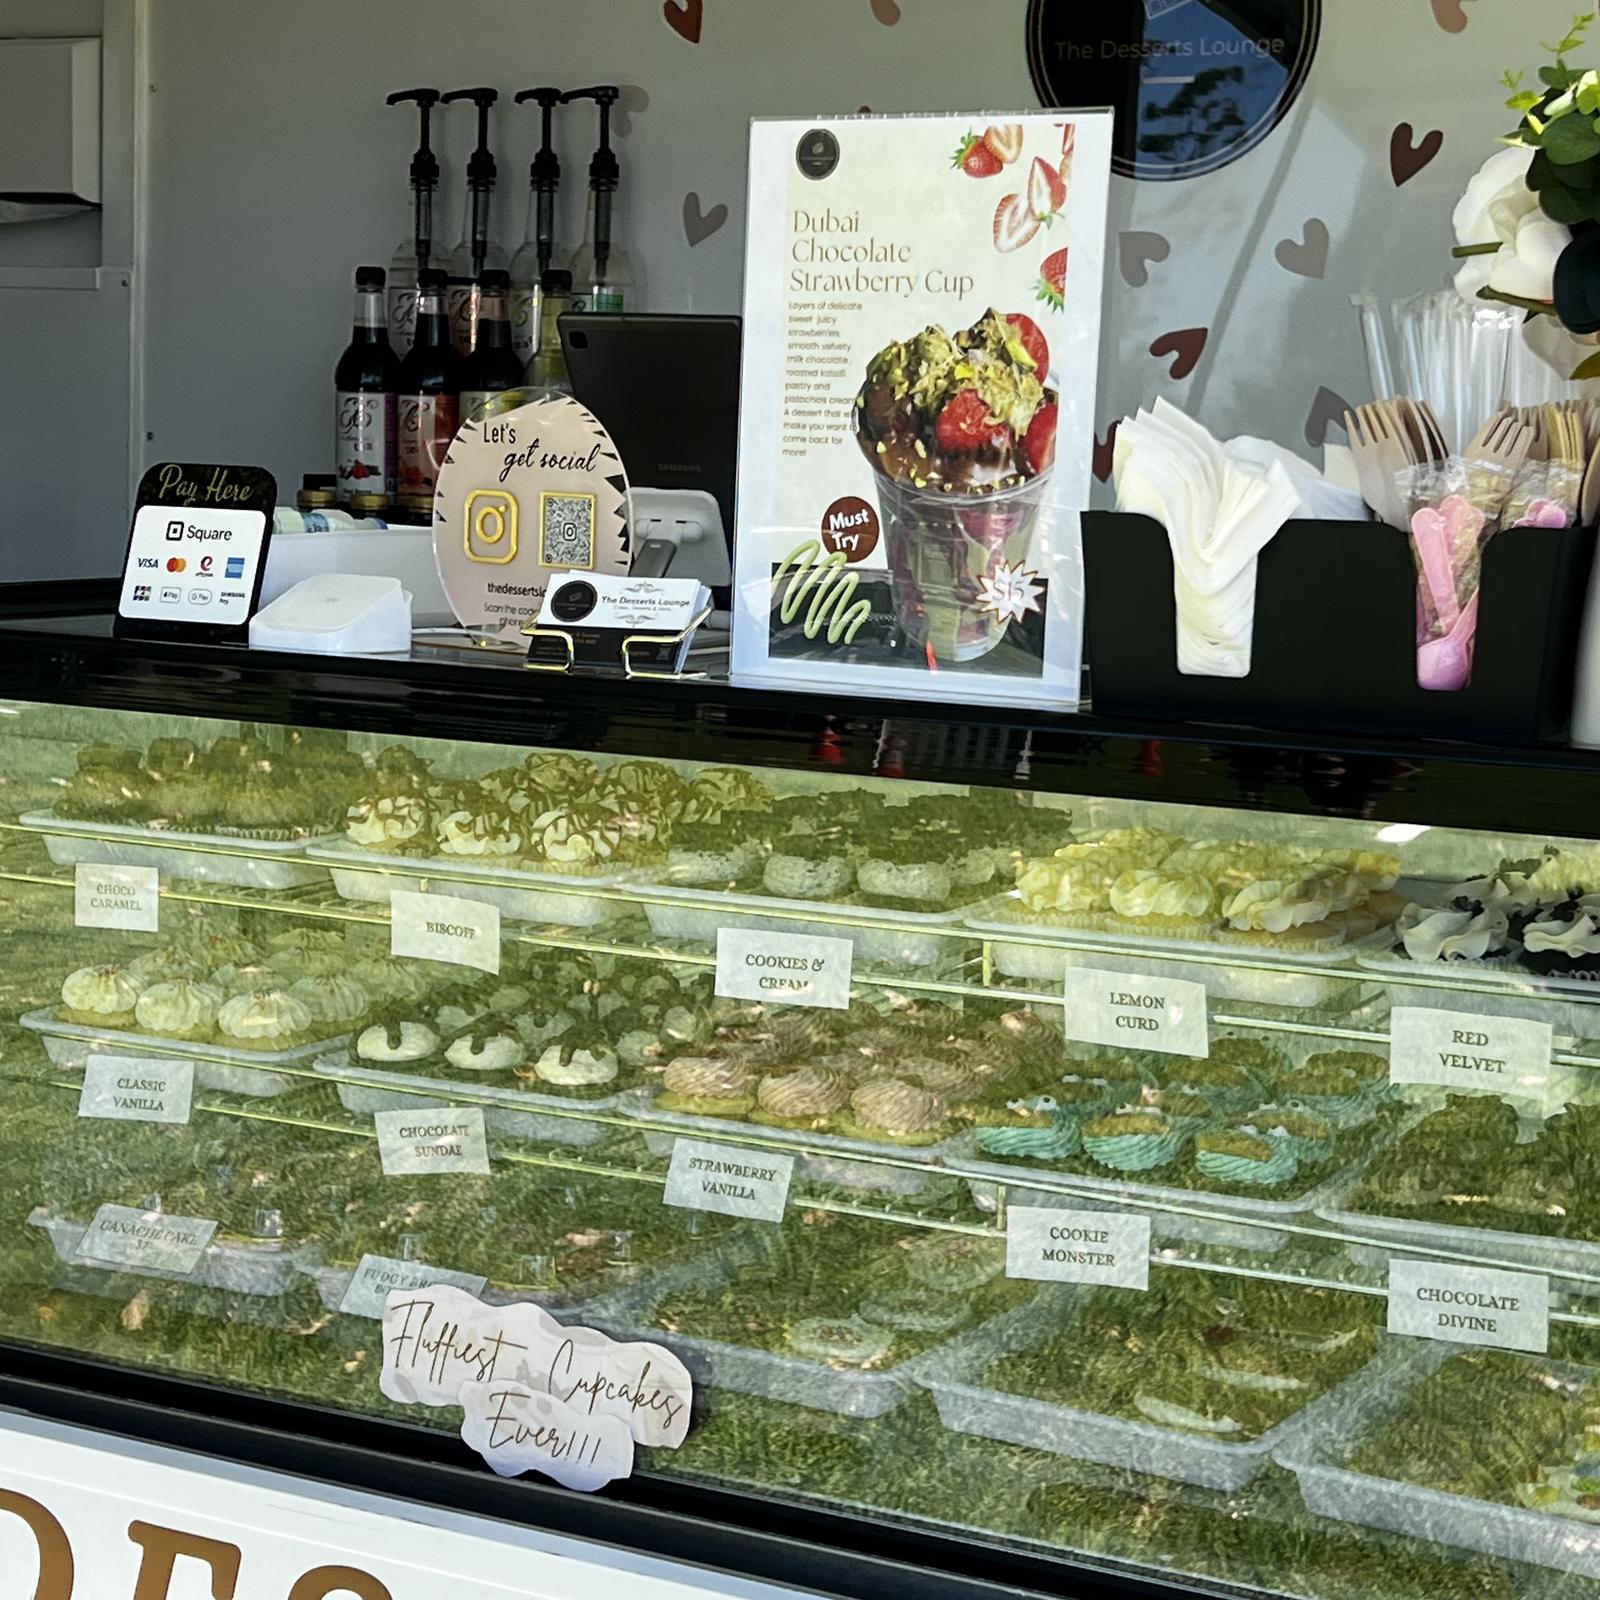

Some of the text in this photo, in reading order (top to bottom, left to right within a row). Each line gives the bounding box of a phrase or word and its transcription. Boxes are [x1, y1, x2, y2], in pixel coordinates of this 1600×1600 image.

[1054, 36, 1285, 60] The Desserts Lounge
[793, 208, 859, 233] Dubai
[792, 237, 911, 263] Chocolate
[790, 267, 974, 300] Strawberry Cup
[784, 408, 790, 416] A
[483, 422, 516, 444] Let's
[499, 438, 602, 483] get social
[158, 464, 254, 506] Pay Here
[829, 508, 869, 531] Must
[186, 525, 233, 543] Square
[832, 532, 859, 551] Try
[137, 558, 159, 569] VISA
[602, 596, 690, 607] The Desserts Lounge
[97, 884, 135, 897] CHOCO
[90, 897, 142, 911] CARAMEL
[745, 953, 824, 972] COOKIES &
[759, 976, 808, 992] CREAM
[1110, 992, 1165, 1009] LEMON
[1116, 1015, 1159, 1031] CURD
[1452, 1030, 1489, 1047] RED
[1439, 1053, 1506, 1073] VELVET
[116, 1077, 166, 1092] CLASSIC
[113, 1096, 164, 1111] VANILLA
[400, 1125, 470, 1138] CHOCOLATE
[415, 1144, 463, 1157] SUNDAE
[688, 1157, 778, 1182] STRAWBERRY
[702, 1180, 756, 1200] VANILLA
[100, 1219, 198, 1246] GANACHE CAKE
[1050, 1226, 1109, 1244] COOKIE
[1041, 1248, 1116, 1267] MONSTER
[363, 1267, 409, 1286] FUDGY
[1416, 1287, 1520, 1311] CHOCOLATE
[1438, 1313, 1497, 1332] DIVINE
[390, 1299, 683, 1429] Fluffiest Cupcakes
